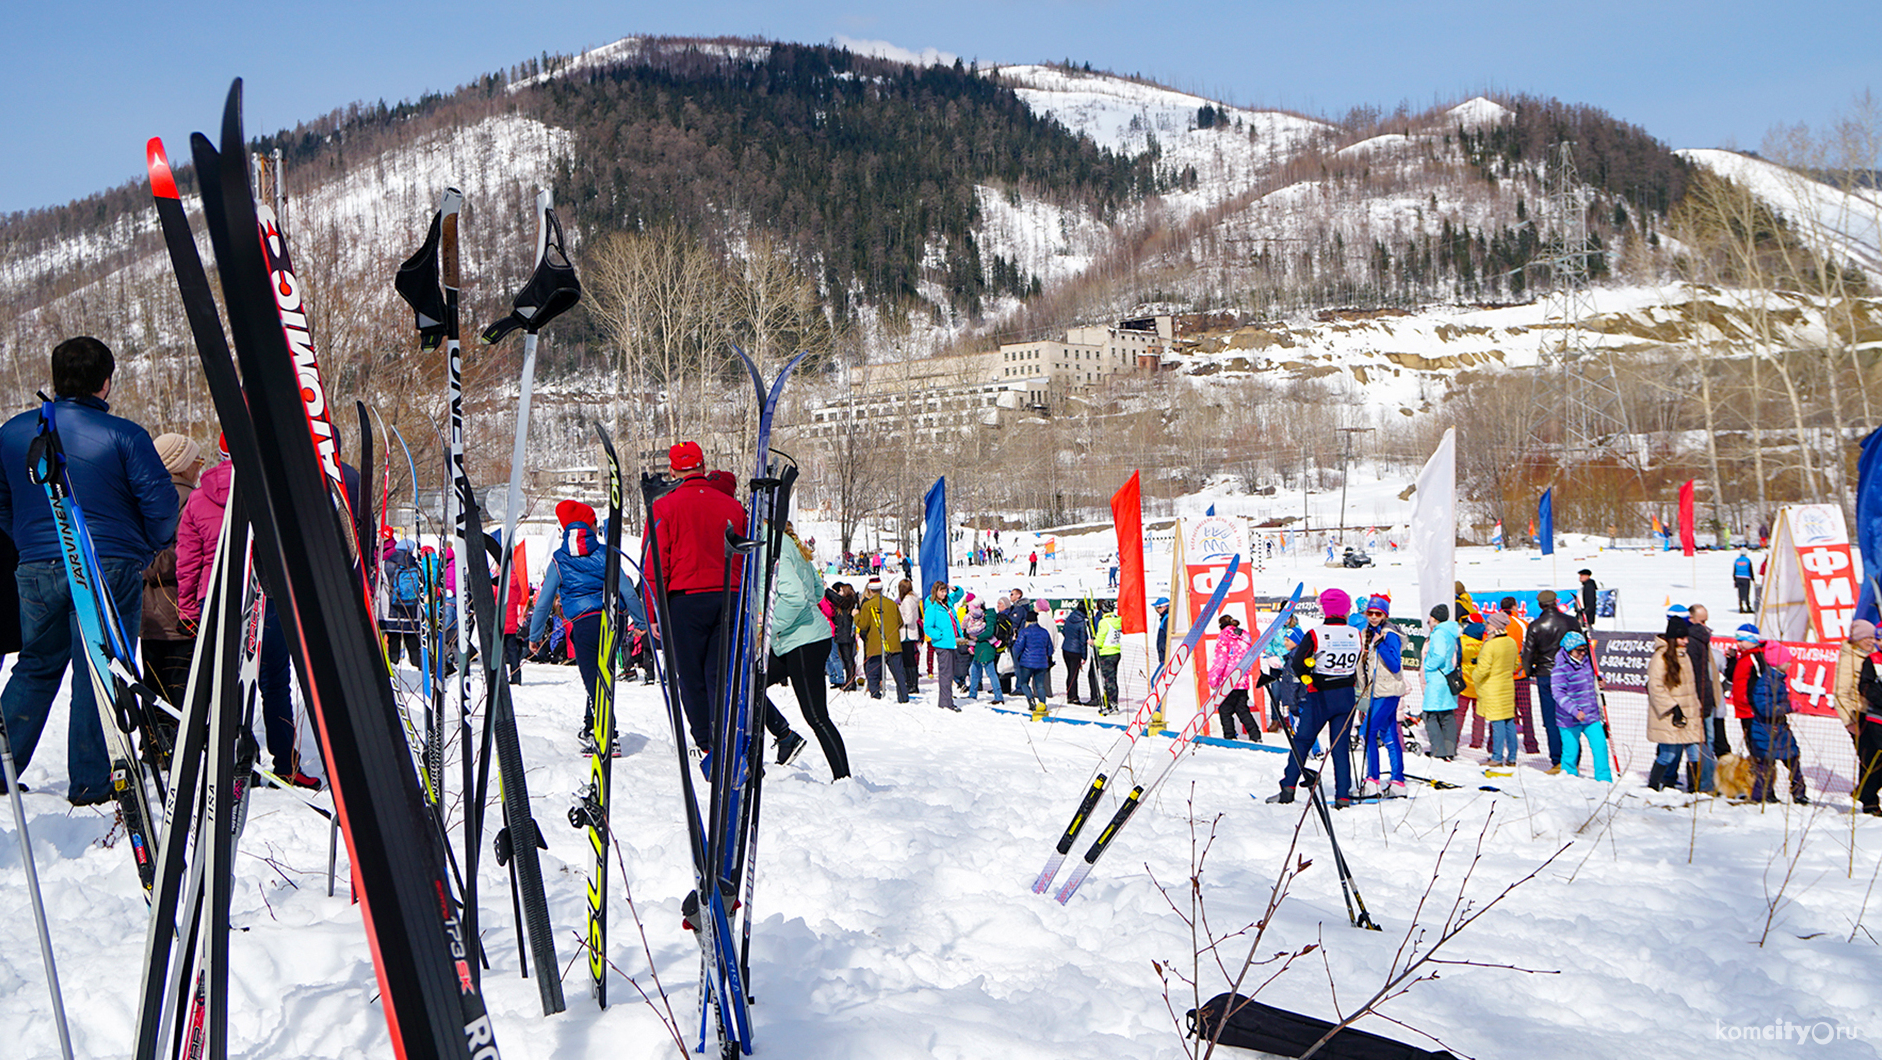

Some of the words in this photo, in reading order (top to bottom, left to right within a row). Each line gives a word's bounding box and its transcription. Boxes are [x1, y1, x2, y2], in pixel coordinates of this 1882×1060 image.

[271, 269, 343, 483] ATOMIC
[49, 495, 89, 590] JÄRVINEN
[247, 599, 260, 653] RACE
[1324, 652, 1357, 669] 349
[1599, 655, 1652, 669] 8-924-218-7
[1125, 643, 1190, 744] YOKO
[1169, 667, 1243, 760] YOKO
[427, 729, 440, 799] NORDWAY
[165, 787, 177, 826] TISA
[207, 784, 216, 823] TISA
[189, 814, 198, 849] TISA
[728, 958, 740, 993] TISA
